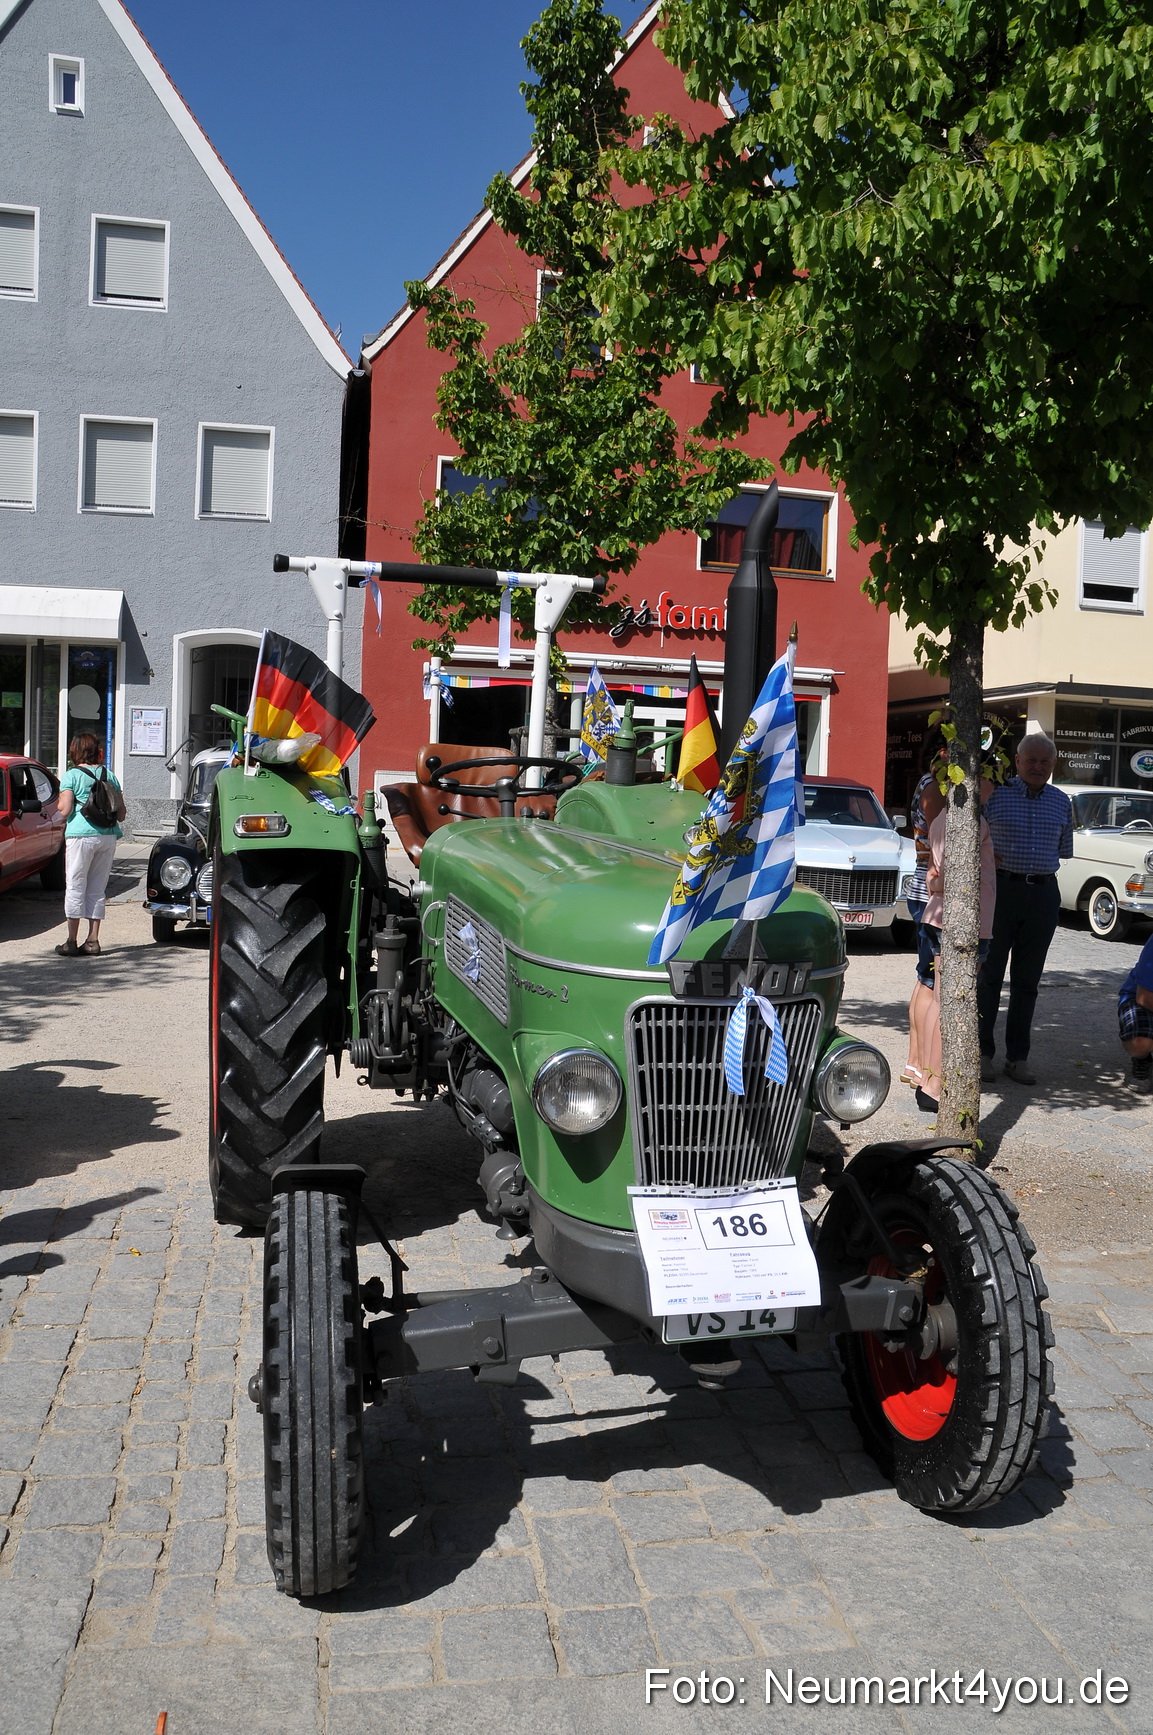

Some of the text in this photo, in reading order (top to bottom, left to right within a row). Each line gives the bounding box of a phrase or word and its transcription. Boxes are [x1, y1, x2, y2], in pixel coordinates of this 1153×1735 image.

[1056, 729, 1115, 739] ELSBETH MÜLLER
[1058, 750, 1087, 760] Kräuter
[1093, 752, 1111, 761] Tees
[1068, 760, 1100, 769] Gewürze
[669, 961, 813, 997] FENDT
[712, 1213, 768, 1238] 186
